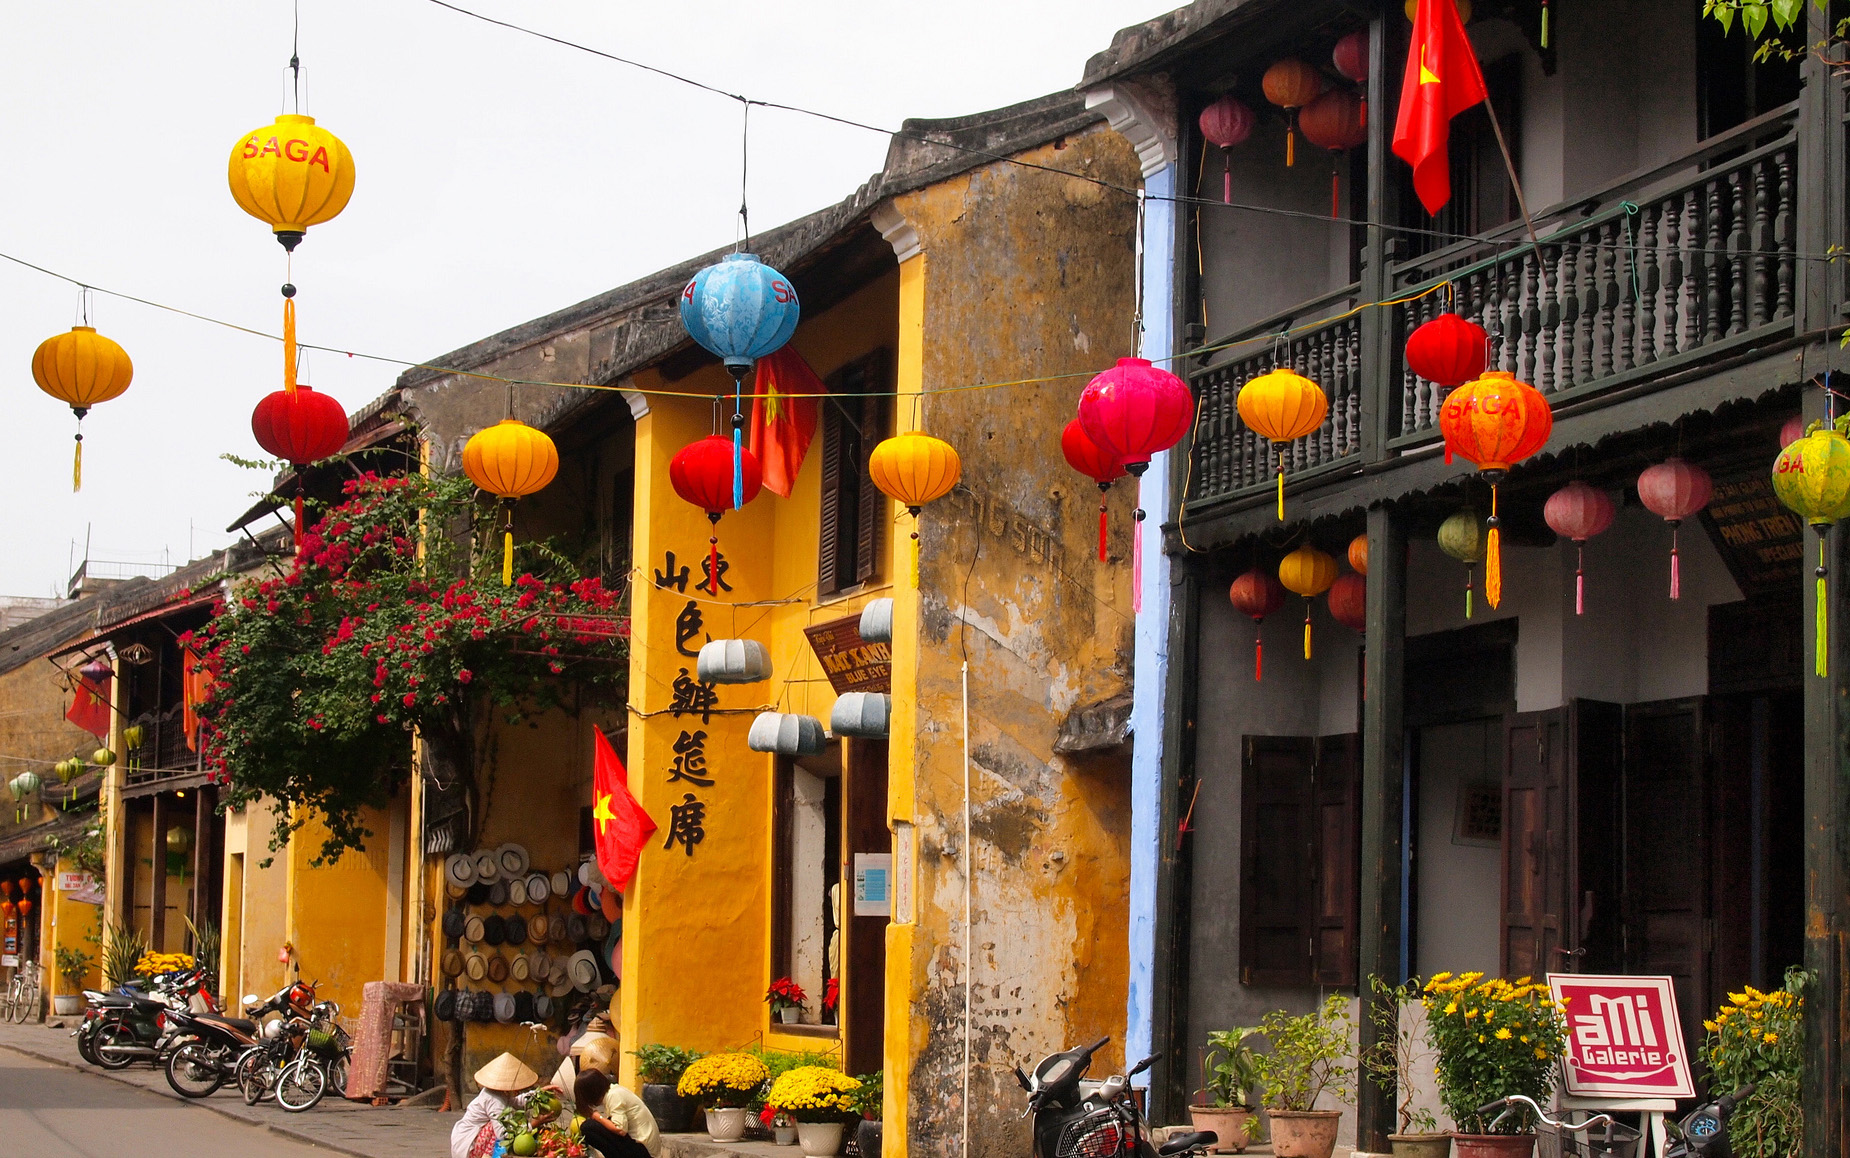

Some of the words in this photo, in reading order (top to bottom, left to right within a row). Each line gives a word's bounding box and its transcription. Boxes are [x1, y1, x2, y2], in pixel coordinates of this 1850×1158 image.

[243, 136, 329, 174] SAGA
[1447, 394, 1520, 420] SAGA
[845, 669, 869, 684] BLUE
[868, 665, 888, 679] EYE
[1581, 1046, 1662, 1065] Galerie
